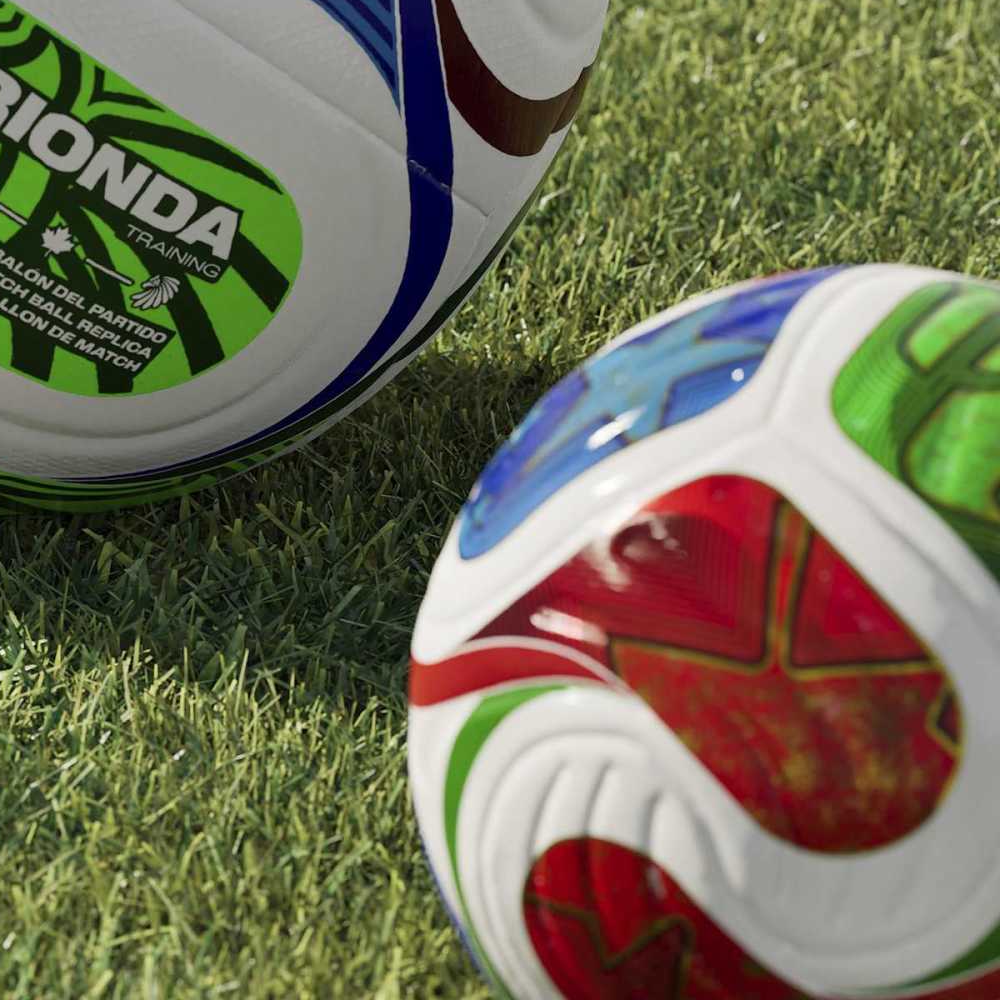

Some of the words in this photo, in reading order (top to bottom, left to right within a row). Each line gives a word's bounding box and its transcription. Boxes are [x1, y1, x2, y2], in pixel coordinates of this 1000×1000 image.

[127, 223, 221, 278] TRAINING
[27, 293, 74, 325] BALL
[76, 318, 153, 359] REPLICA
[51, 284, 86, 310] DEL
[87, 303, 168, 343] PARTIDO
[47, 325, 77, 345] DE
[74, 338, 143, 372] MATCH
